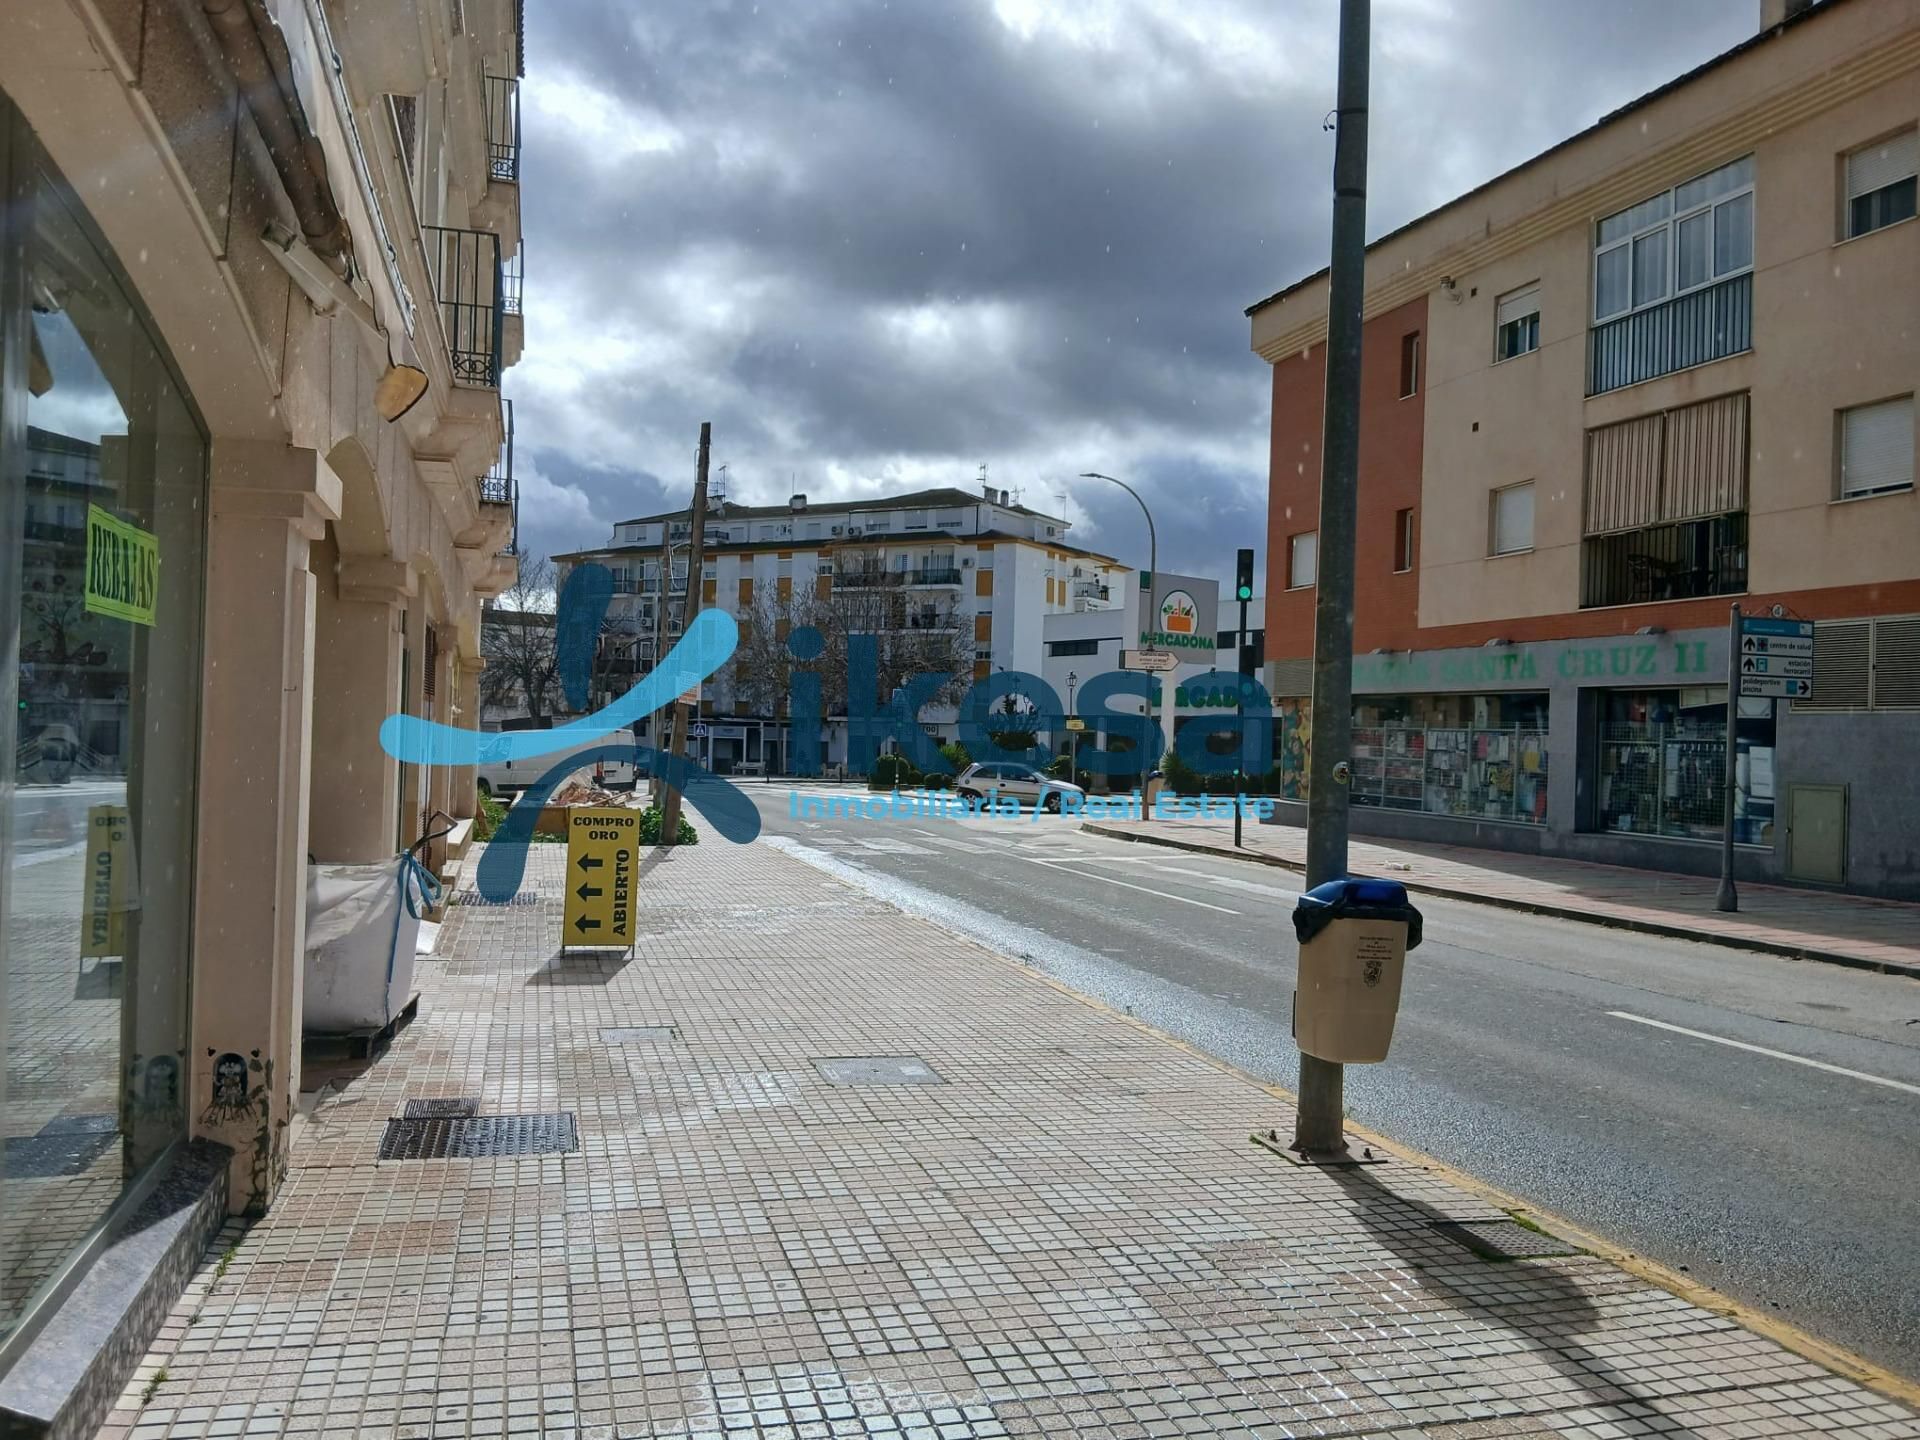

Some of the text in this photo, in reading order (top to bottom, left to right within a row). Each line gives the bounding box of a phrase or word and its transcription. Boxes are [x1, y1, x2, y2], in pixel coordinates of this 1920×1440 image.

[88, 522, 155, 611] REBAJAS
[1140, 631, 1215, 650] MERCADONA
[1769, 640, 1812, 651] centro de salud
[1557, 643, 1657, 678] CRUZ
[1673, 641, 1708, 673] II
[573, 816, 635, 827] COMPRO
[588, 830, 619, 841] ORO
[613, 849, 630, 937] ABIERTO
